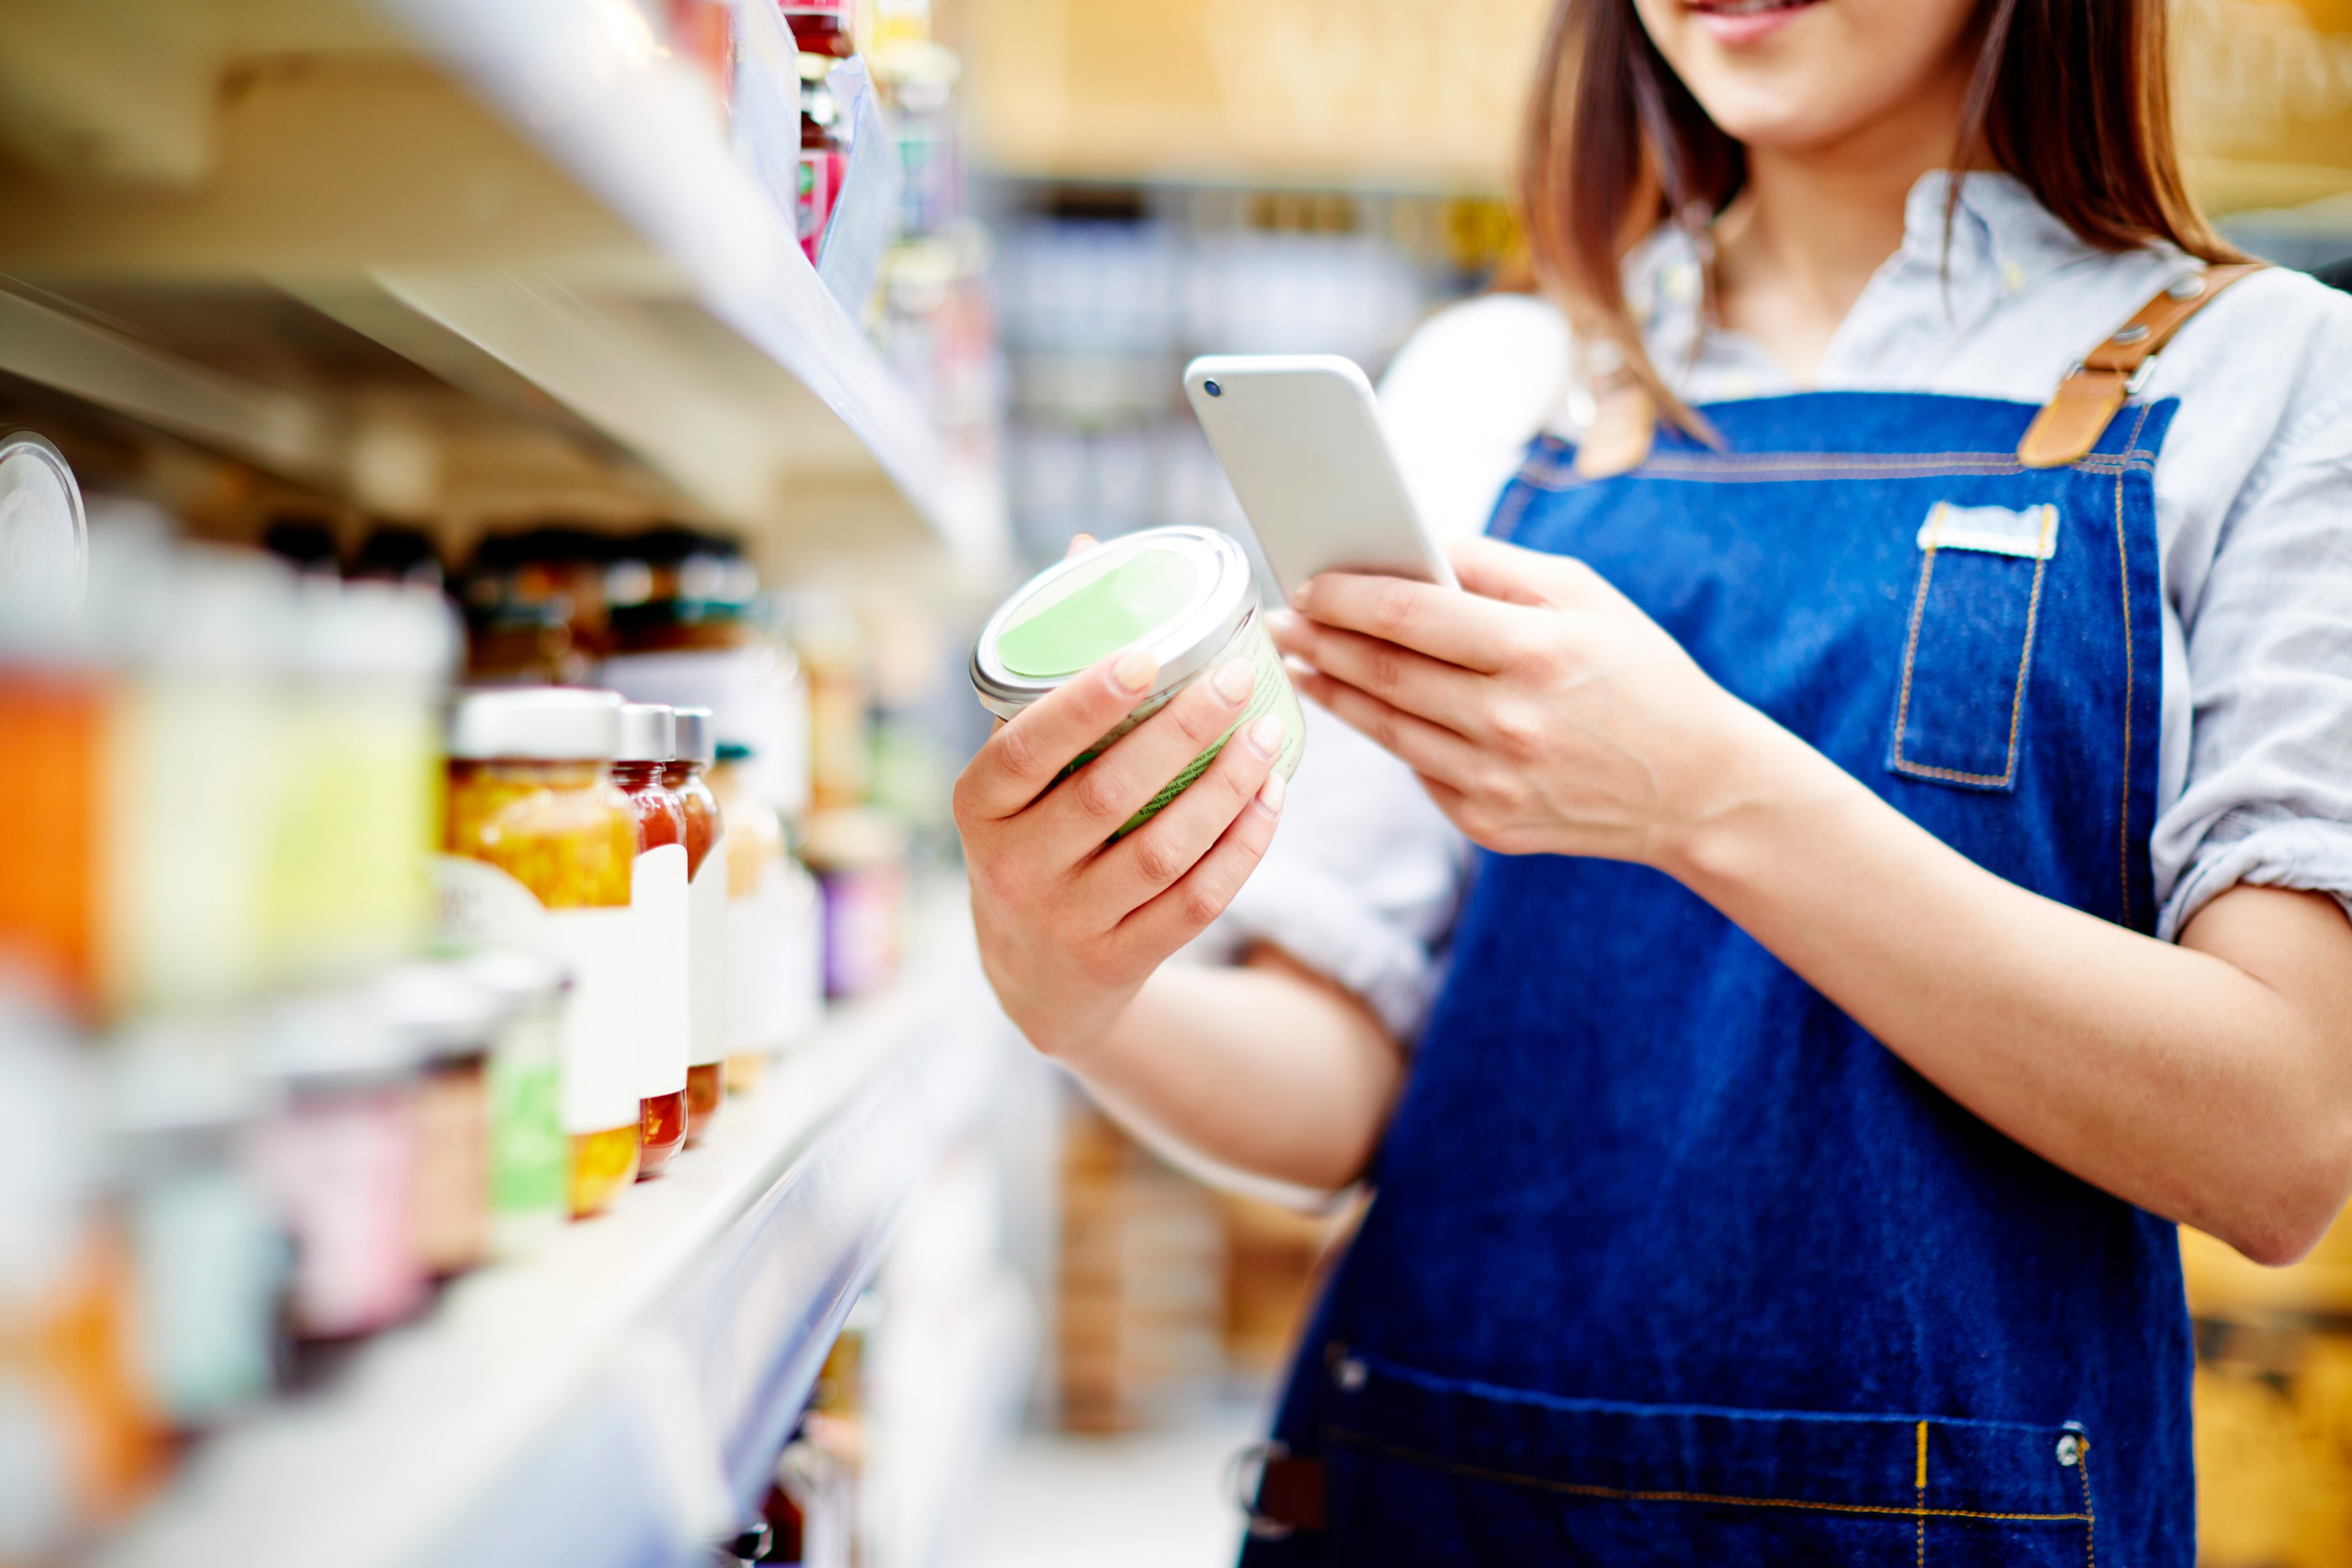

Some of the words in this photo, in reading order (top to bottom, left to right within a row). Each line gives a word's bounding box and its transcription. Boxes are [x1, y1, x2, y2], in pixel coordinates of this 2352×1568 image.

[1193, 753, 1207, 764] once
[1206, 744, 1223, 756] sweet,
[1158, 782, 1181, 795] seafood,
[1180, 772, 1199, 786] spread
[1173, 769, 1193, 782] umami
[1145, 805, 1160, 814] chips
